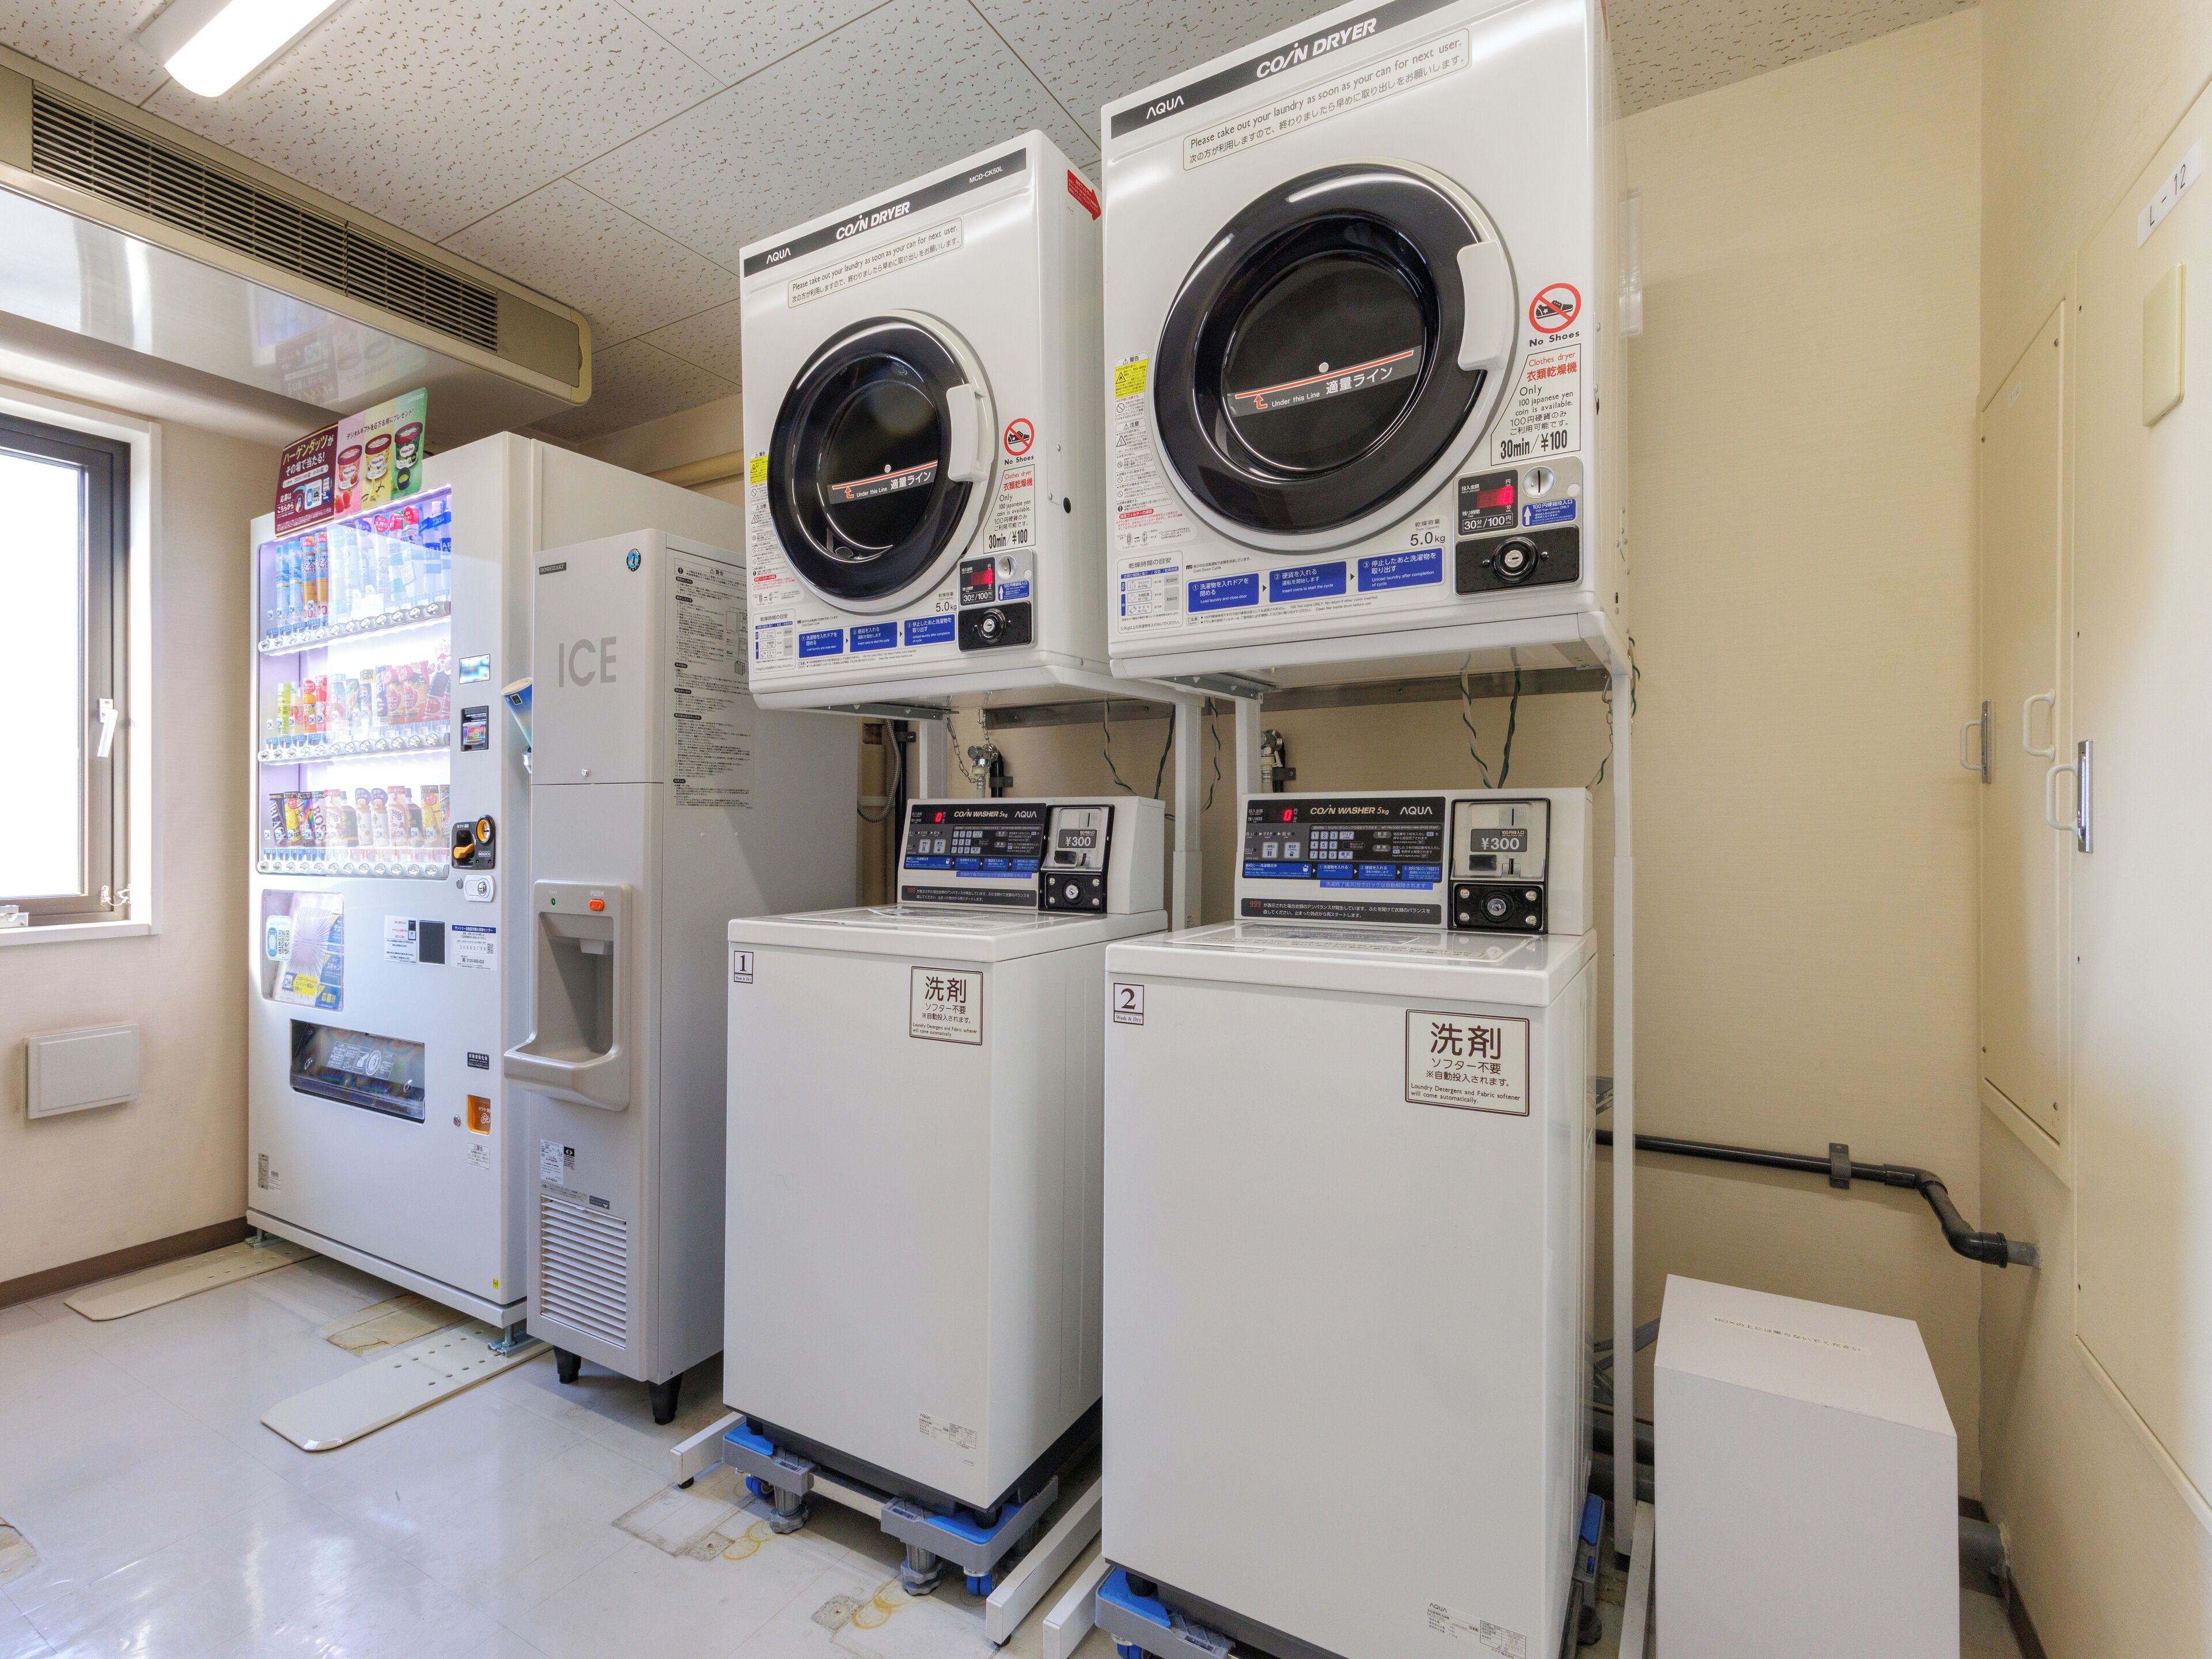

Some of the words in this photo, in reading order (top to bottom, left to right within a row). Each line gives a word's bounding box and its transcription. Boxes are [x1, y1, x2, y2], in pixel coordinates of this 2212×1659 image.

[1256, 42, 1308, 78] COIN
[1313, 18, 1377, 60] DRYER
[1190, 134, 1215, 149] Please
[1217, 126, 1235, 139] take
[1237, 120, 1251, 131] out
[1253, 112, 1271, 128] your
[1274, 99, 1304, 118] laundry
[1318, 87, 1339, 100] soon
[1342, 82, 1351, 90] as
[1354, 73, 1374, 90] your
[1376, 66, 1391, 78] can
[1394, 60, 1409, 71] for
[1412, 50, 1434, 64] next
[1438, 40, 1461, 54] user.
[1146, 95, 1184, 119] AQUA
[969, 166, 1003, 184] MCD-CK50L
[2149, 204, 2156, 228] L
[2173, 162, 2187, 196] 12
[836, 214, 869, 240] COIN
[870, 201, 910, 227] DRYER
[766, 248, 791, 264] AQUA
[792, 280, 808, 291] Please
[809, 276, 821, 285] take
[822, 272, 830, 281] out
[832, 267, 843, 279] your
[844, 260, 863, 272] laundry
[872, 253, 885, 263] soon
[893, 244, 906, 257] your
[906, 240, 916, 249] can
[918, 237, 927, 245] for
[928, 231, 942, 241] next
[944, 225, 958, 236] user.
[1529, 338, 1544, 347] No
[1548, 331, 1580, 343] Shoes
[1528, 357, 1555, 367] Clothes
[1558, 352, 1576, 363] dryer
[1527, 361, 1577, 382] 衣類乾燥機
[1325, 365, 1393, 396] 適量ライン
[1520, 384, 1542, 396] Only
[1271, 398, 1291, 408] Under
[1293, 395, 1305, 404] this
[1306, 391, 1320, 400] Line
[1519, 398, 1529, 406] 100
[1531, 394, 1559, 407] japanese
[1562, 391, 1573, 400] yen
[1541, 400, 1573, 411] available.
[1510, 411, 1567, 427] 100円硬貨のみ
[1510, 419, 1568, 435] ご利用可能です。
[282, 434, 334, 465] ハーゲンダッツが
[286, 452, 325, 476] その場で当たる!
[1016, 455, 1034, 463] Shoes
[891, 471, 931, 490] 適量ライン
[1005, 472, 1019, 480] Clothes
[1003, 477, 1033, 491] 衣類乾燥機
[999, 493, 1013, 502] Only
[277, 502, 294, 513] こちらから
[1006, 501, 1022, 510] japanese
[994, 514, 1028, 525] 100円硬貨のみ
[994, 521, 1028, 531] ご利用可能です。
[1464, 520, 1476, 530] 30
[1128, 557, 1172, 569] 乾燥時間の目安
[1371, 552, 1437, 567] 停止したあと洗濯物を
[540, 564, 564, 573] HOSHIZAKI
[1282, 569, 1317, 579] 硬貨を入れる
[1371, 565, 1397, 575] 取り出す
[1199, 578, 1249, 590] 洗濯物を入れドアを
[964, 594, 971, 602] 30
[558, 637, 617, 688] ICE
[935, 812, 942, 823] 0
[954, 809, 971, 817] COIN
[1283, 809, 1293, 822] 0
[1310, 804, 1336, 815] COIN
[1338, 806, 1376, 815] WASHER
[1376, 806, 1389, 816] 5kg
[1400, 806, 1433, 815] AQUA
[1065, 836, 1092, 847] ¥300
[1481, 837, 1520, 850] ¥300
[740, 954, 747, 972] 1
[925, 976, 967, 1003] 洗剤
[1120, 988, 1136, 1010] 2
[925, 1003, 967, 1015] ソフター不要
[1430, 1022, 1501, 1060] 洗剤
[1431, 1058, 1502, 1075] ソフター不要
[1435, 1085, 1463, 1094] Detergent
[1497, 1092, 1521, 1101] softener
[1440, 1094, 1479, 1104] automatically.
[1714, 1317, 1862, 1352] BOXの上には乗らないでください
[1429, 1603, 1448, 1613] AQUA
